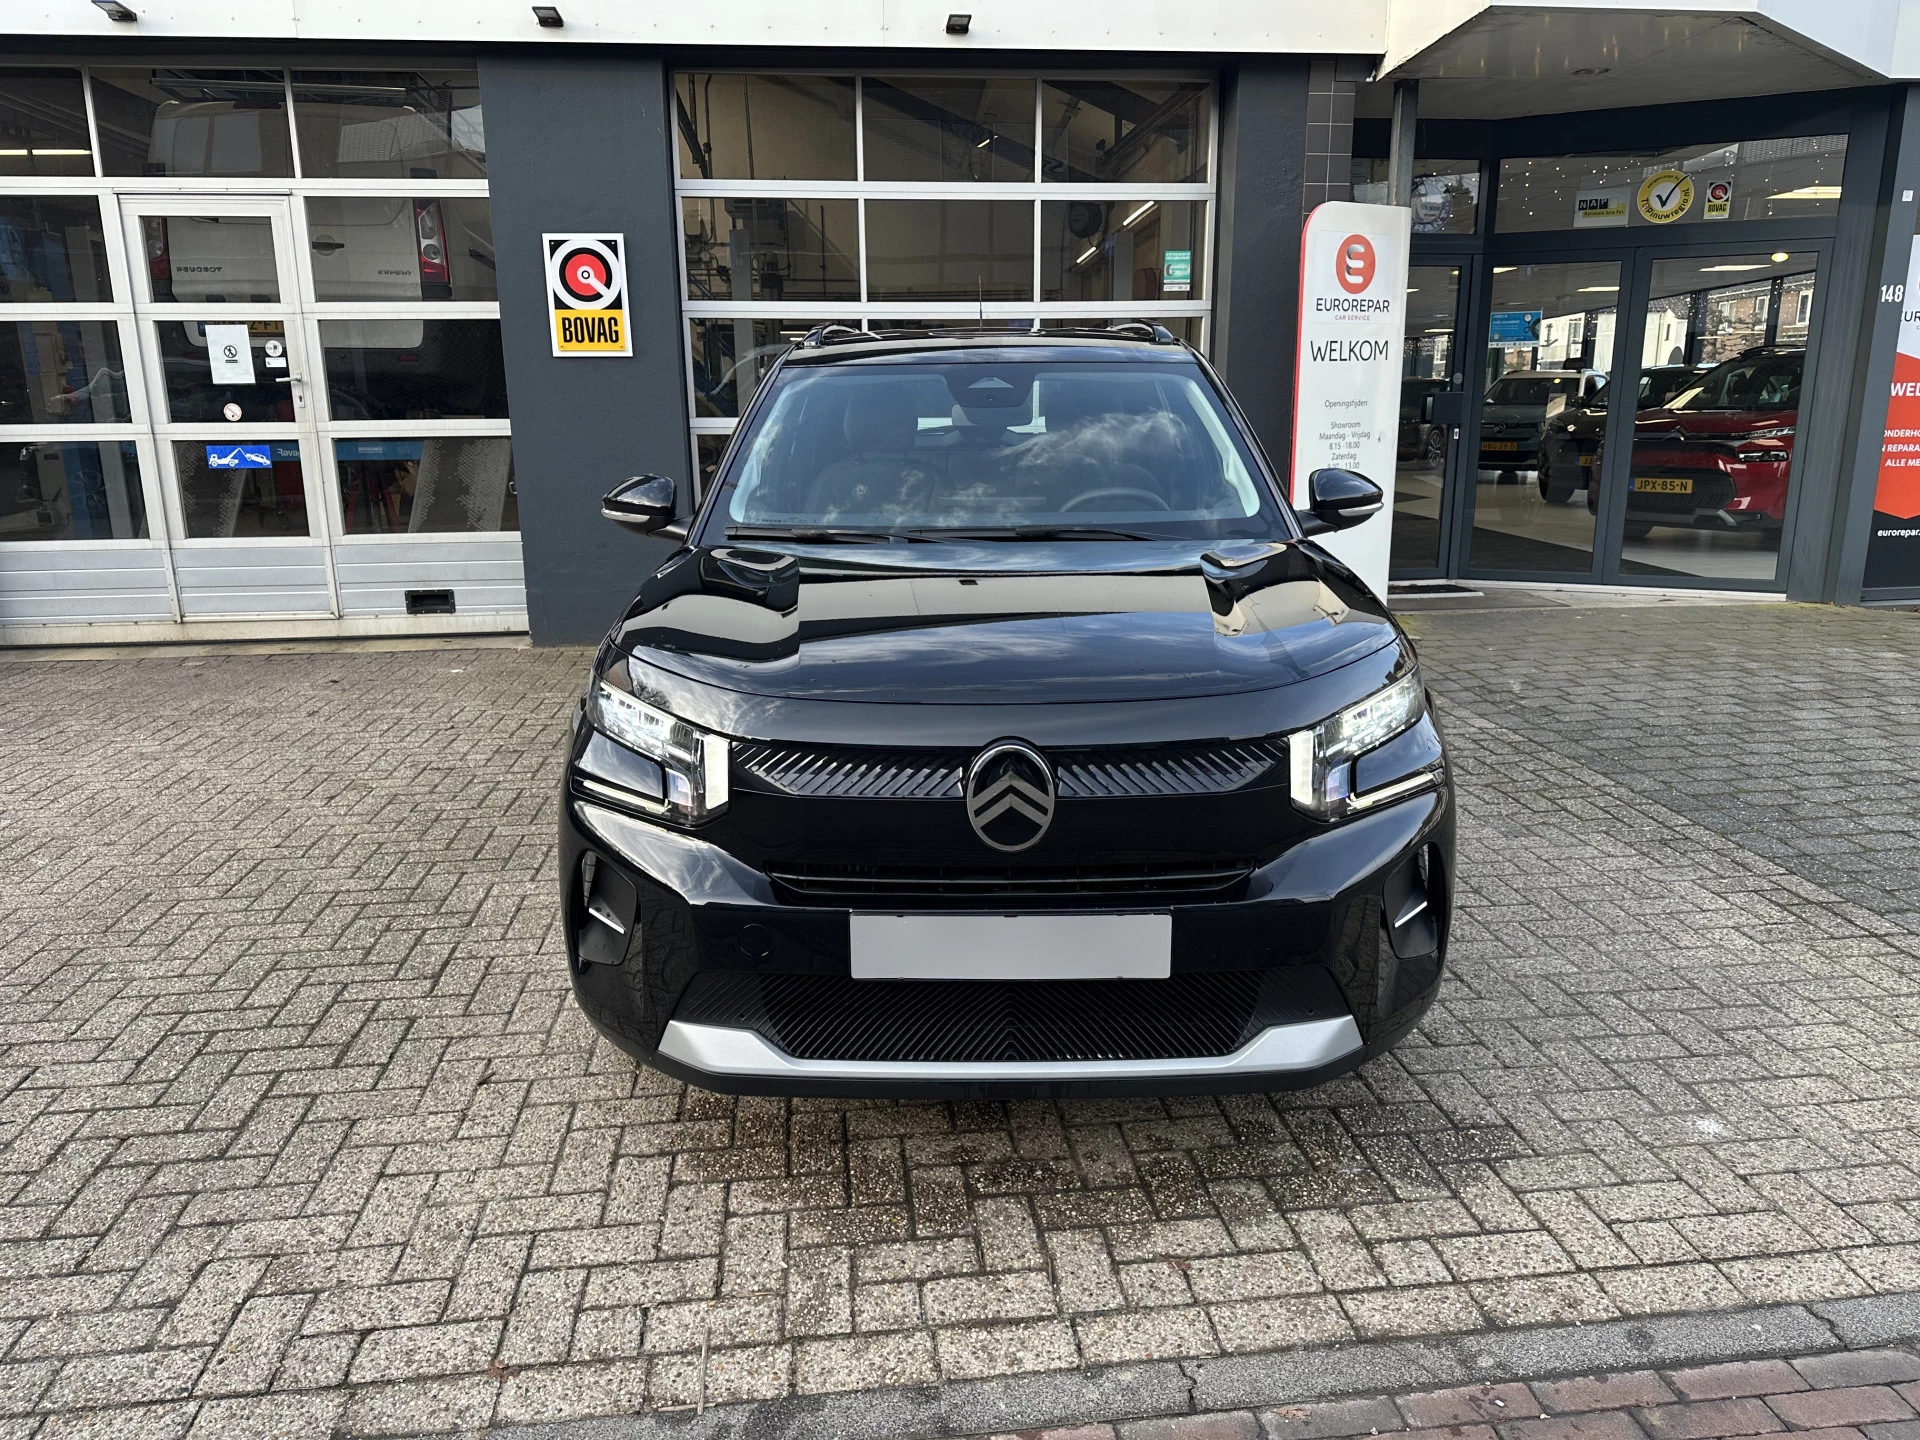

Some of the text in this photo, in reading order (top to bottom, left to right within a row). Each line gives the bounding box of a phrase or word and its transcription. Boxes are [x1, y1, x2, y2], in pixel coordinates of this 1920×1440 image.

[1579, 198, 1608, 210] NAP
[1707, 203, 1727, 213] BOVAG
[1880, 284, 1904, 303] 148
[1316, 297, 1390, 313] EUROREPAR
[1347, 314, 1371, 322] SERVICE
[1900, 310, 1920, 323] UR
[561, 316, 620, 344] BOVAG
[1310, 340, 1389, 362] WELKOM
[1330, 421, 1361, 429] Showroom
[1319, 432, 1346, 441] Maandag
[1351, 431, 1371, 441] Vrijdag
[1331, 452, 1357, 461] Zaterdag
[1884, 458, 1907, 467] ALLE
[1637, 479, 1688, 492] JPX-85-N
